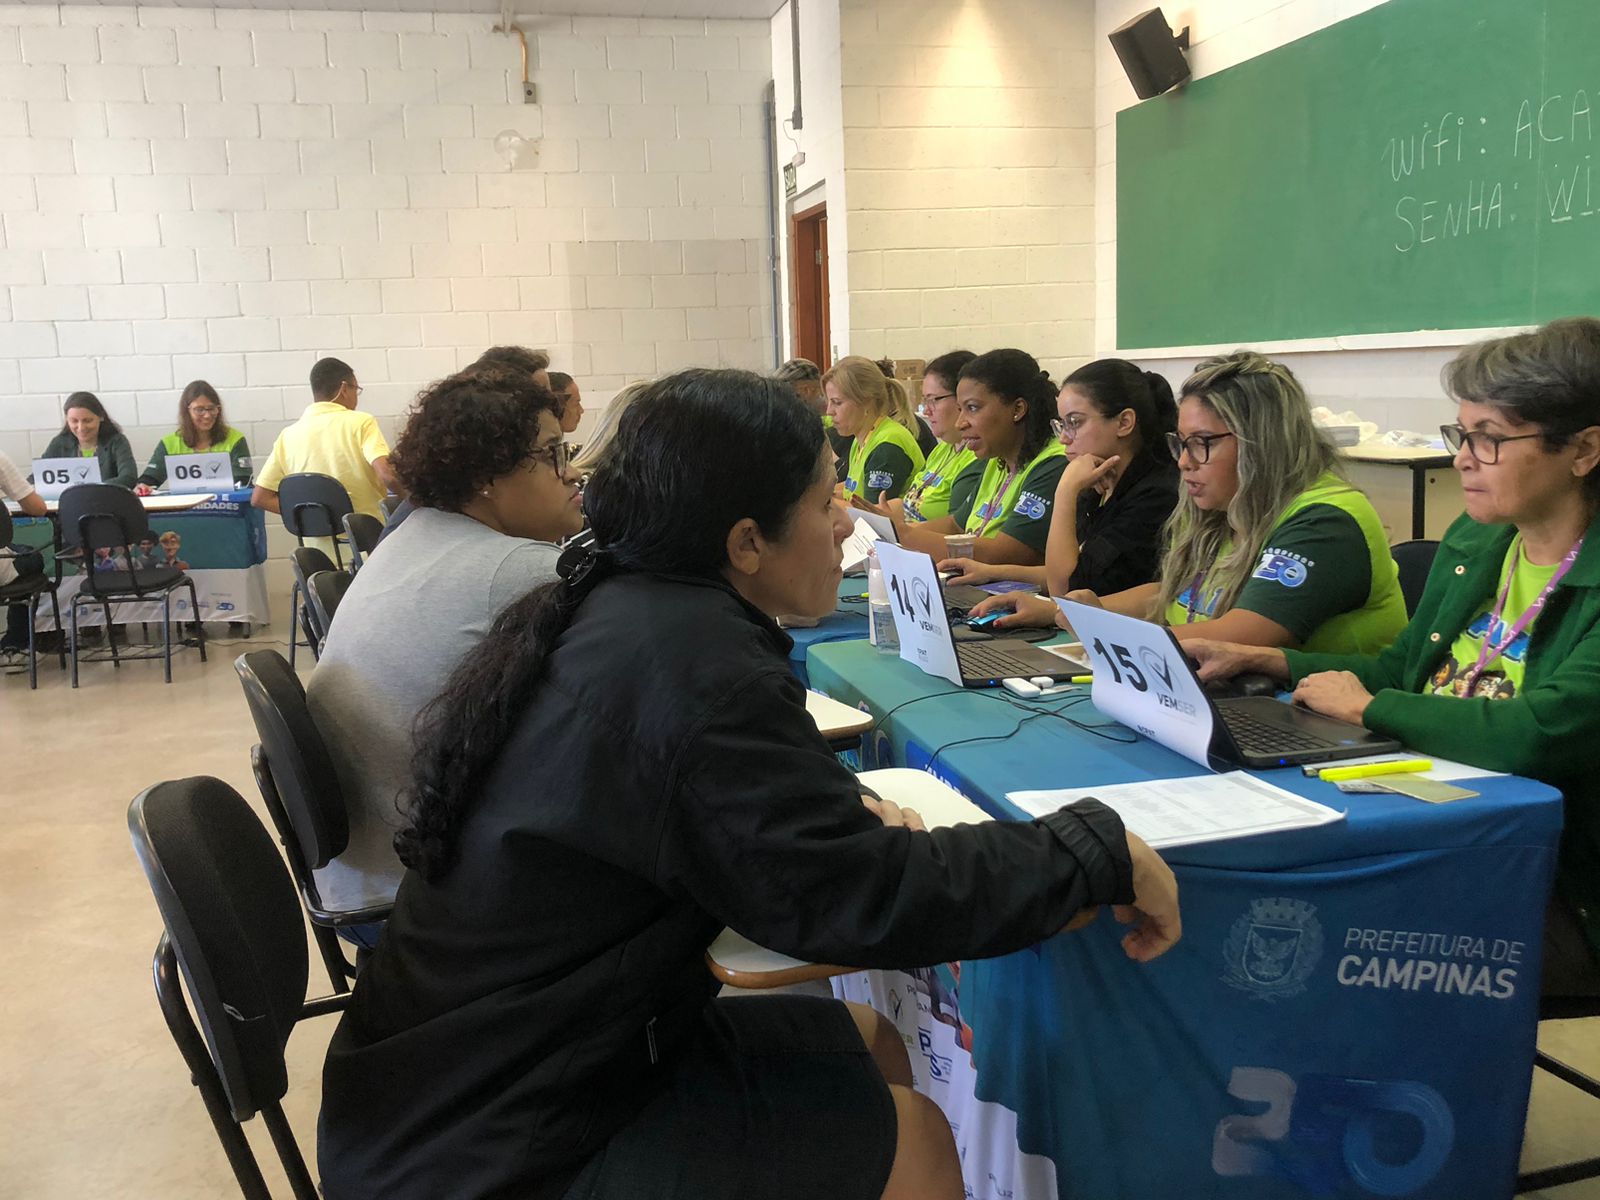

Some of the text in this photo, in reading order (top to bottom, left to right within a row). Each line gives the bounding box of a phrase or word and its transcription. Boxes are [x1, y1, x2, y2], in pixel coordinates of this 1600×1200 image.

[1514, 89, 1600, 159] ACA
[42, 469, 70, 485] 05
[175, 465, 202, 480] 06
[891, 574, 916, 623] 14
[1093, 637, 1148, 692] 15
[1344, 928, 1525, 964] PREFEITURA DE
[1337, 954, 1518, 999] CAMPINAS
